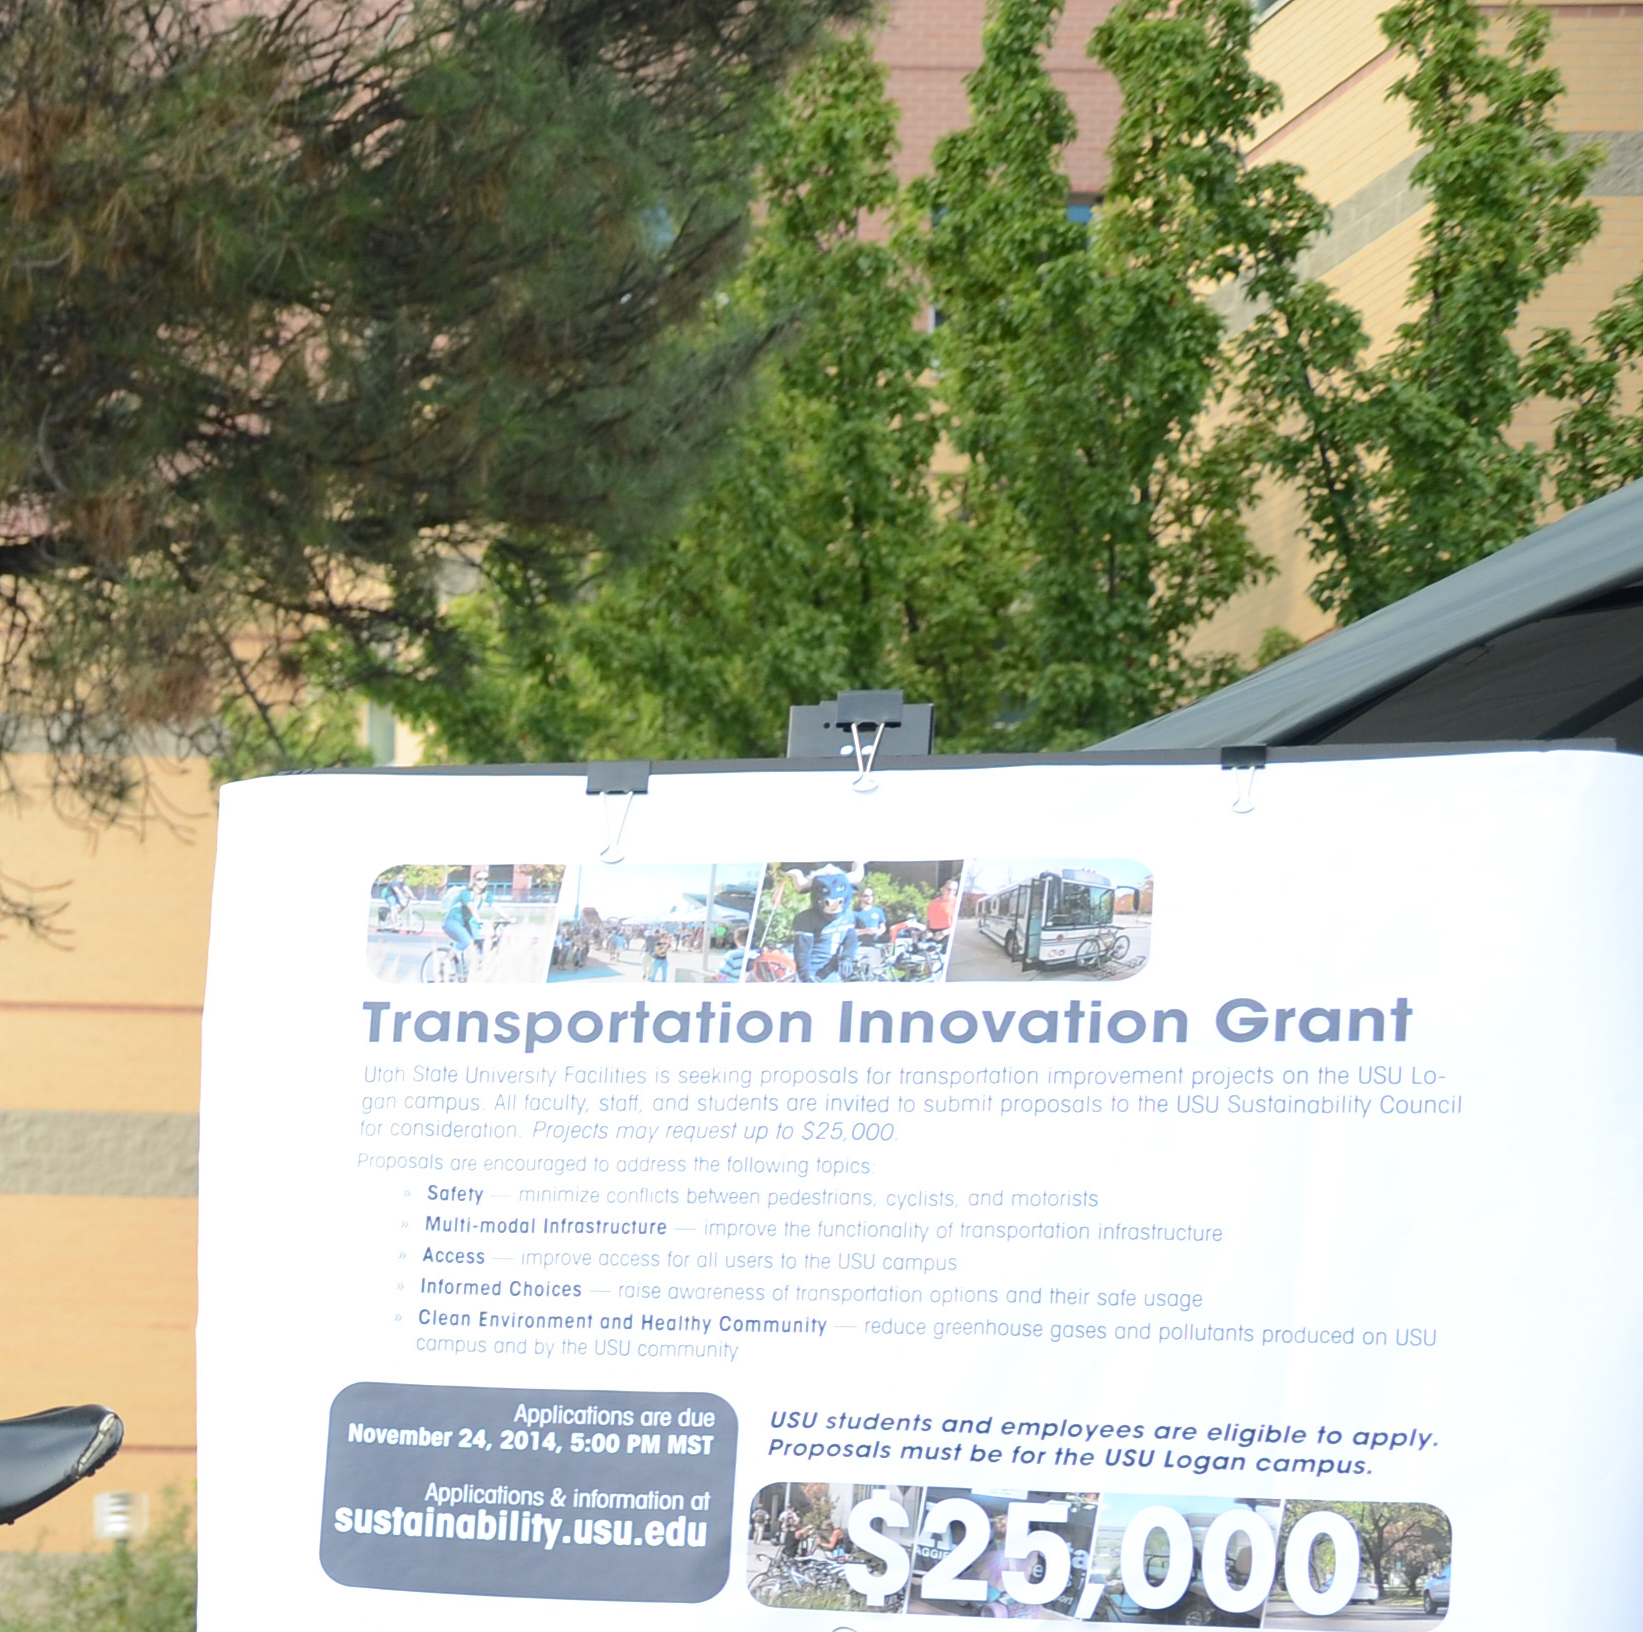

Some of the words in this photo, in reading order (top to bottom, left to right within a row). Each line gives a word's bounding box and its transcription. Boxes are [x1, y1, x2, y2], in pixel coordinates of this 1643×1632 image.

[363, 1000, 812, 1054] Transportation
[839, 999, 1188, 1044] Innovation
[1216, 998, 1413, 1044] Grant
[363, 1065, 406, 1084] Utah
[411, 1064, 460, 1085] State
[464, 1066, 558, 1089] University
[563, 1065, 648, 1086] Facilities
[654, 1069, 671, 1085] is
[677, 1067, 753, 1090] seeking
[759, 1065, 860, 1089] proposals
[865, 1065, 893, 1086] for
[898, 1065, 1040, 1090] transportation
[1046, 1065, 1185, 1090] improvement
[1190, 1065, 1275, 1091] projects
[1281, 1068, 1310, 1085] on
[1317, 1065, 1351, 1086] the
[1357, 1064, 1404, 1086] USU
[360, 1095, 398, 1116] gan
[492, 1093, 518, 1112] All
[651, 1093, 691, 1112] and
[696, 1093, 781, 1113] students
[785, 1096, 818, 1113] are
[824, 1093, 891, 1114] invited
[897, 1095, 916, 1114] to
[922, 1093, 994, 1114] submit
[999, 1094, 1104, 1118] proposals
[1110, 1095, 1130, 1114] to
[1137, 1094, 1170, 1114] the
[1175, 1093, 1221, 1115] USU
[1226, 1093, 1373, 1120] Sustainability
[1378, 1093, 1464, 1115] Council
[359, 1119, 384, 1138] for
[531, 1119, 610, 1144] Projects
[614, 1124, 661, 1145] may
[664, 1121, 739, 1144] request
[742, 1124, 771, 1145] up
[774, 1121, 795, 1141] to
[425, 1183, 485, 1207] Safety
[518, 1188, 601, 1205] minimize
[605, 1186, 681, 1205] conflicts
[685, 1186, 762, 1206] between
[967, 1189, 1005, 1208] and
[1010, 1189, 1100, 1208] motorists
[424, 1215, 537, 1235] Multi-modal
[542, 1216, 669, 1237] Infrastructure
[703, 1221, 778, 1241] improve
[783, 1220, 812, 1238] the
[817, 1219, 930, 1243] functionality
[935, 1221, 955, 1240] of
[959, 1221, 1091, 1242] transportation
[1097, 1221, 1224, 1243] infrastructure
[420, 1245, 487, 1266] Access
[419, 1276, 503, 1298] Informed
[508, 1279, 583, 1299] Choices
[617, 1284, 663, 1300] raise
[666, 1285, 766, 1302] awareness
[771, 1283, 791, 1303] of
[795, 1284, 924, 1306] transportation
[928, 1286, 1000, 1307] options
[1004, 1286, 1043, 1306] and
[1048, 1286, 1091, 1306] their
[1096, 1288, 1138, 1308] safe
[1143, 1292, 1204, 1313] usage
[417, 1308, 473, 1328] Clean
[477, 1310, 594, 1330] Environment
[598, 1313, 635, 1331] and
[640, 1313, 713, 1336] Healthy
[717, 1314, 828, 1337] Community
[864, 1317, 928, 1336] reduce
[932, 1318, 1045, 1341] greenhouse
[1049, 1323, 1108, 1344] gases
[1113, 1322, 1152, 1341] and
[1157, 1322, 1255, 1345] pollutants
[1260, 1326, 1356, 1348] produced
[1361, 1330, 1389, 1346] on
[1394, 1327, 1438, 1348] USU
[512, 1403, 636, 1429] Applications
[638, 1410, 674, 1427] are
[676, 1407, 717, 1428] due
[769, 1411, 820, 1429] USU
[824, 1412, 934, 1432] students
[940, 1416, 994, 1435] and
[999, 1419, 1146, 1442] employees
[1152, 1425, 1199, 1441] are
[1205, 1423, 1309, 1448] eligible
[1316, 1425, 1344, 1445] to
[1351, 1428, 1440, 1451] apply.
[346, 1422, 455, 1448] November
[456, 1427, 494, 1451] 24,
[498, 1426, 565, 1454] 2014,
[568, 1432, 622, 1454] 5:00
[625, 1434, 663, 1455] PM
[665, 1434, 717, 1455] MST
[766, 1438, 893, 1461] Proposals
[898, 1443, 964, 1461] must
[968, 1443, 1004, 1463] be
[1010, 1446, 1048, 1465] for
[1053, 1447, 1096, 1466] the
[1103, 1448, 1157, 1468] USU
[1162, 1446, 1247, 1475] Logan
[1254, 1457, 1373, 1478] campus.
[423, 1482, 546, 1511] Applications
[548, 1487, 569, 1507] &
[571, 1488, 686, 1511] information
[688, 1491, 713, 1511] at
[332, 1506, 709, 1549] sustainability.usu.edu
[845, 1488, 1361, 1618] $25,000
